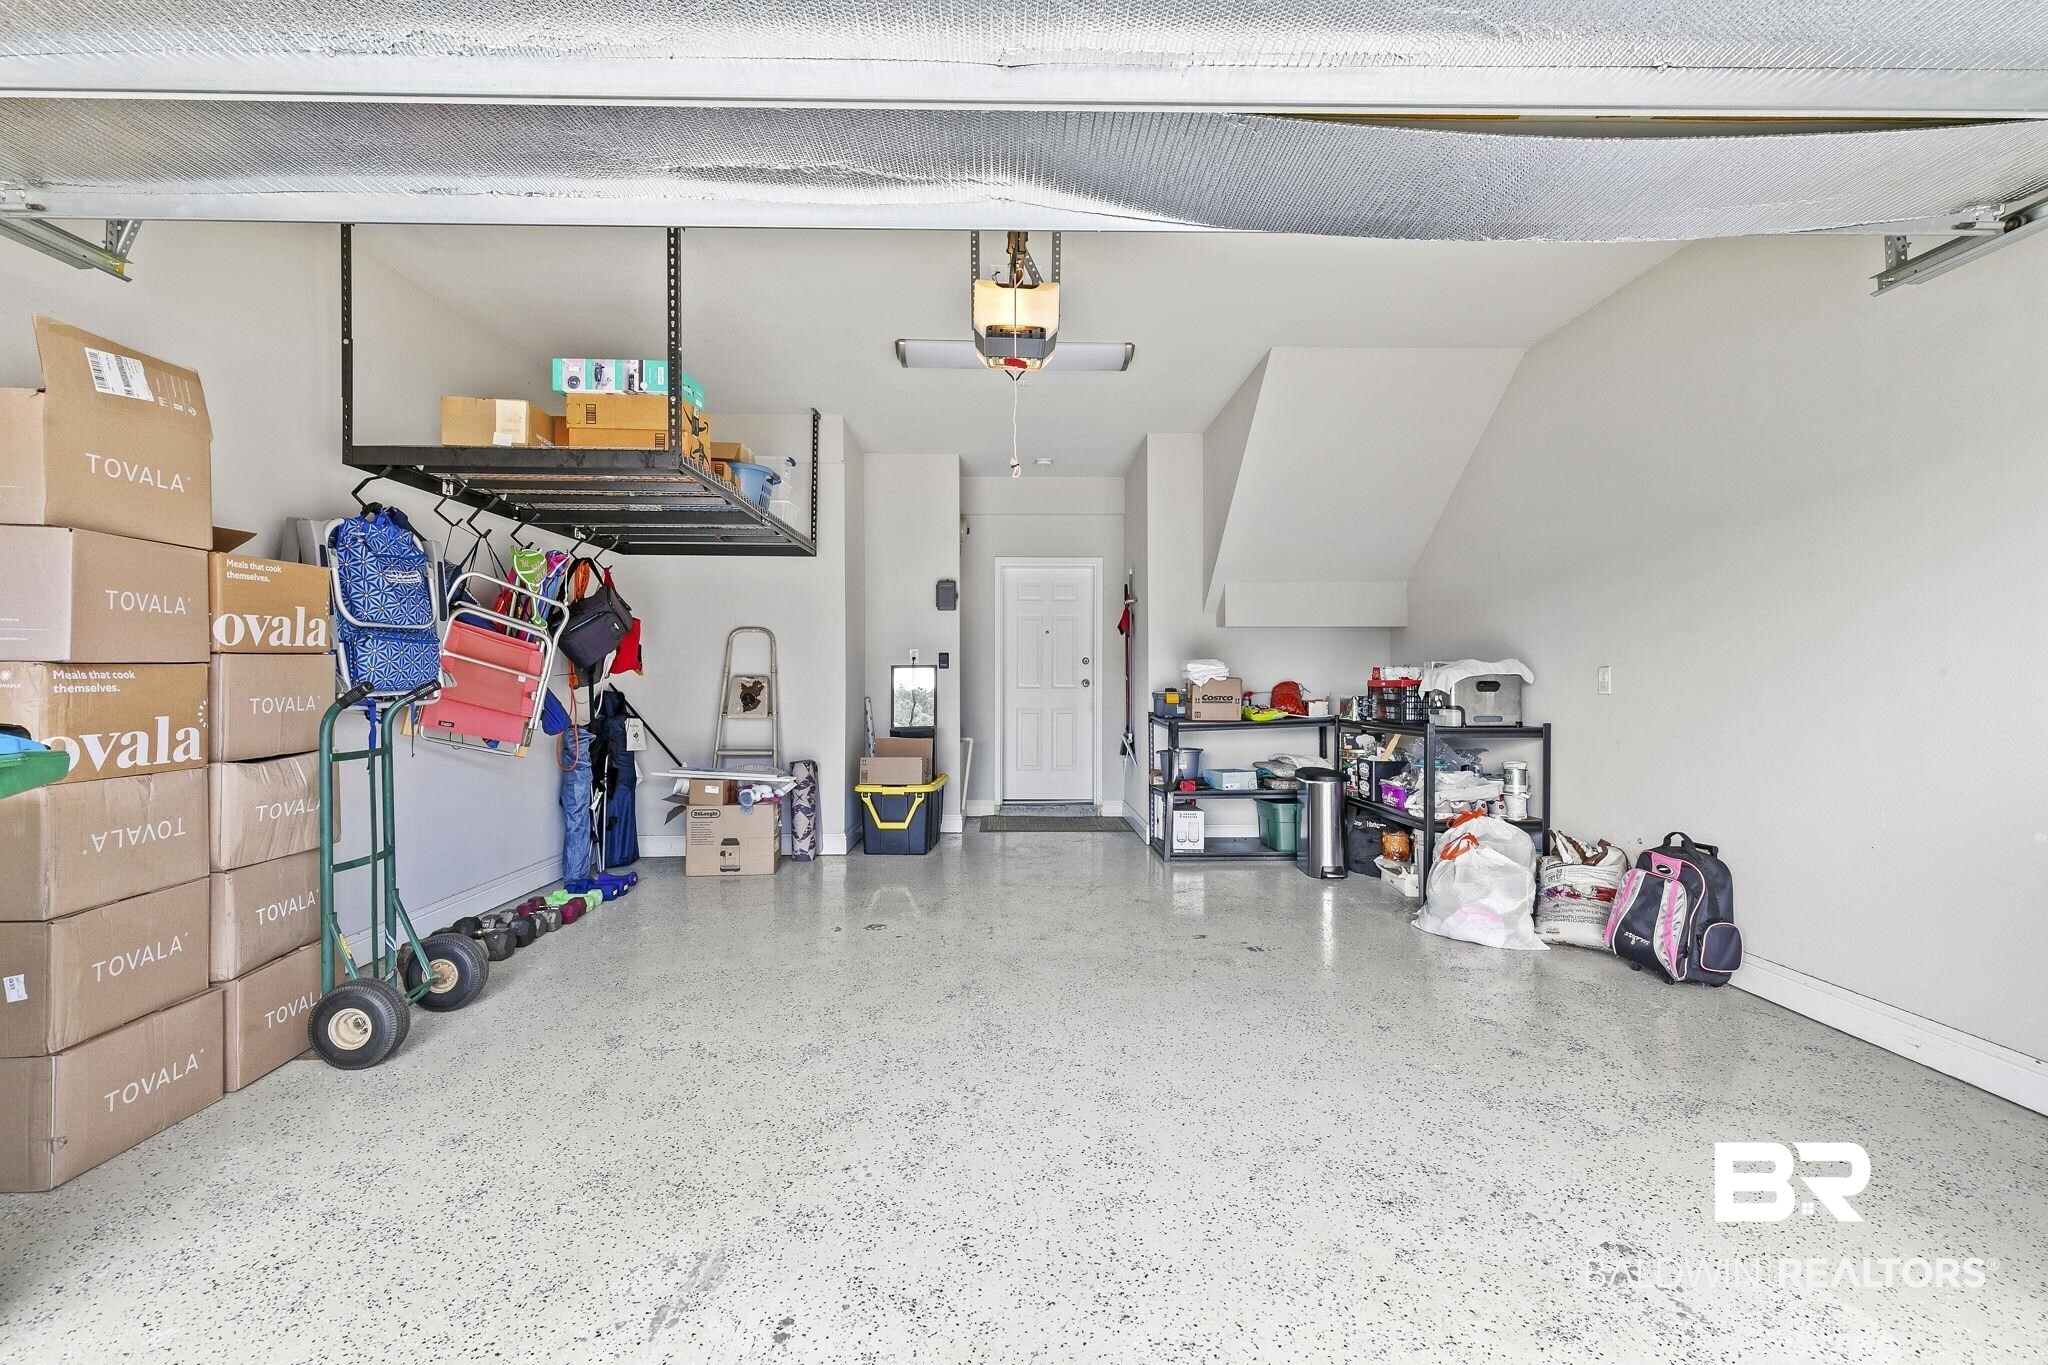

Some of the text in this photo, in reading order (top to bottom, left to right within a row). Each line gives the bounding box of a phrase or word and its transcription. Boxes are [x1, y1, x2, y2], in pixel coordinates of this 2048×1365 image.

[85, 453, 185, 493] TOVALA
[226, 559, 282, 573] Meals that cook
[226, 571, 271, 582] themselves.
[105, 590, 186, 615] TOVALA
[212, 606, 327, 647] ovala
[52, 683, 121, 694] themselves.
[53, 670, 136, 680] Meals that cook
[250, 696, 317, 715] TOVALA
[91, 817, 186, 852] TOVALA
[256, 890, 316, 925] TOVALA
[91, 936, 183, 982] TOVALA
[264, 988, 321, 1029] TOVAL
[104, 1053, 199, 1112] TOVALA
